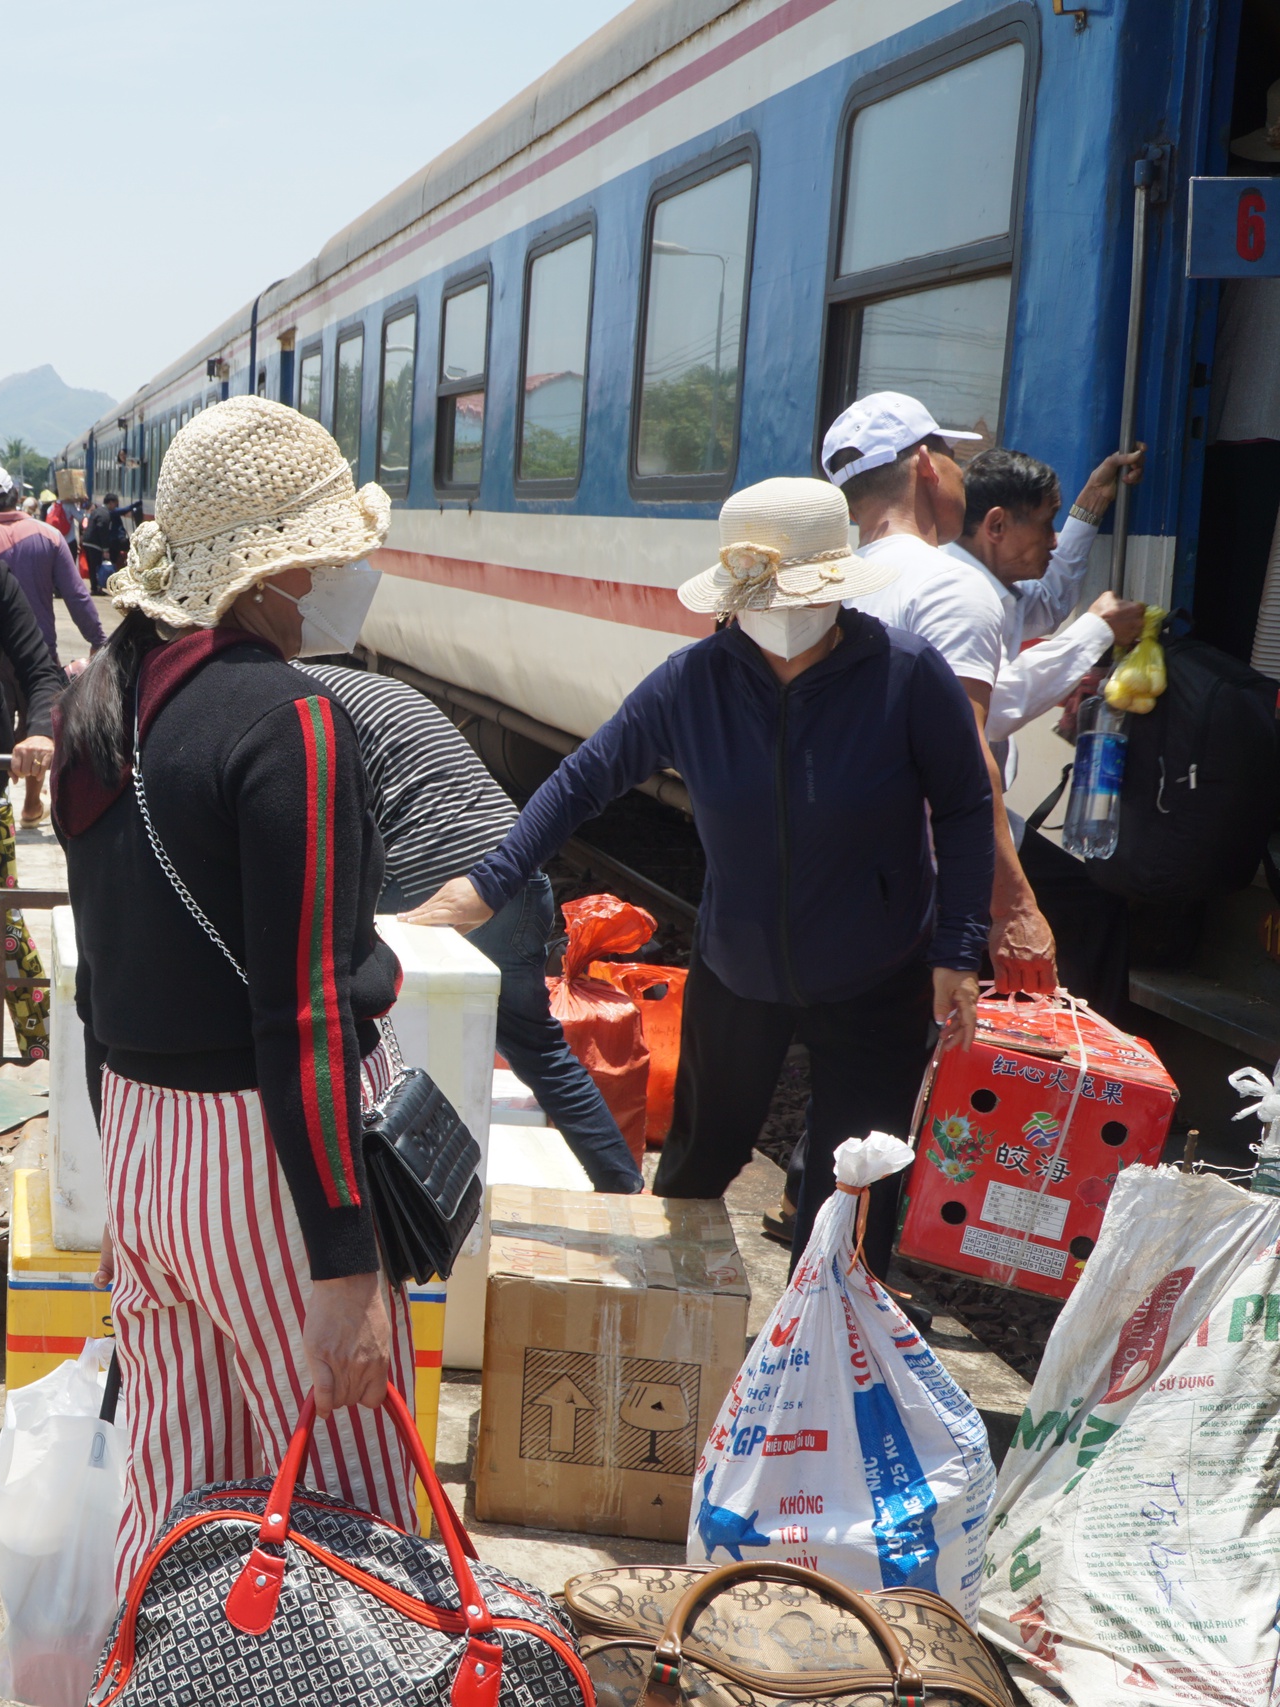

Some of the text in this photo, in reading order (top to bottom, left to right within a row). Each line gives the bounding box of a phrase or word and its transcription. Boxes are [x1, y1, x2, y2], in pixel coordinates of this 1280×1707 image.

[1235, 189, 1266, 262] 6
[992, 1053, 1124, 1106] 红心火龙果
[994, 1142, 1071, 1183] 皎海
[1044, 1249, 1053, 1257] 34
[1029, 1262, 1037, 1270] 51
[1040, 1265, 1049, 1273] 52
[789, 1348, 811, 1372] iệt
[1158, 1373, 1176, 1392] SỬ
[1178, 1374, 1216, 1393] DỤNG
[727, 1425, 767, 1457] GP
[883, 1434, 900, 1460] KG
[892, 1463, 910, 1487] 25
[779, 1490, 824, 1515] KHÔNG
[778, 1524, 809, 1545] TIÊU
[1207, 1634, 1228, 1644] NAM
